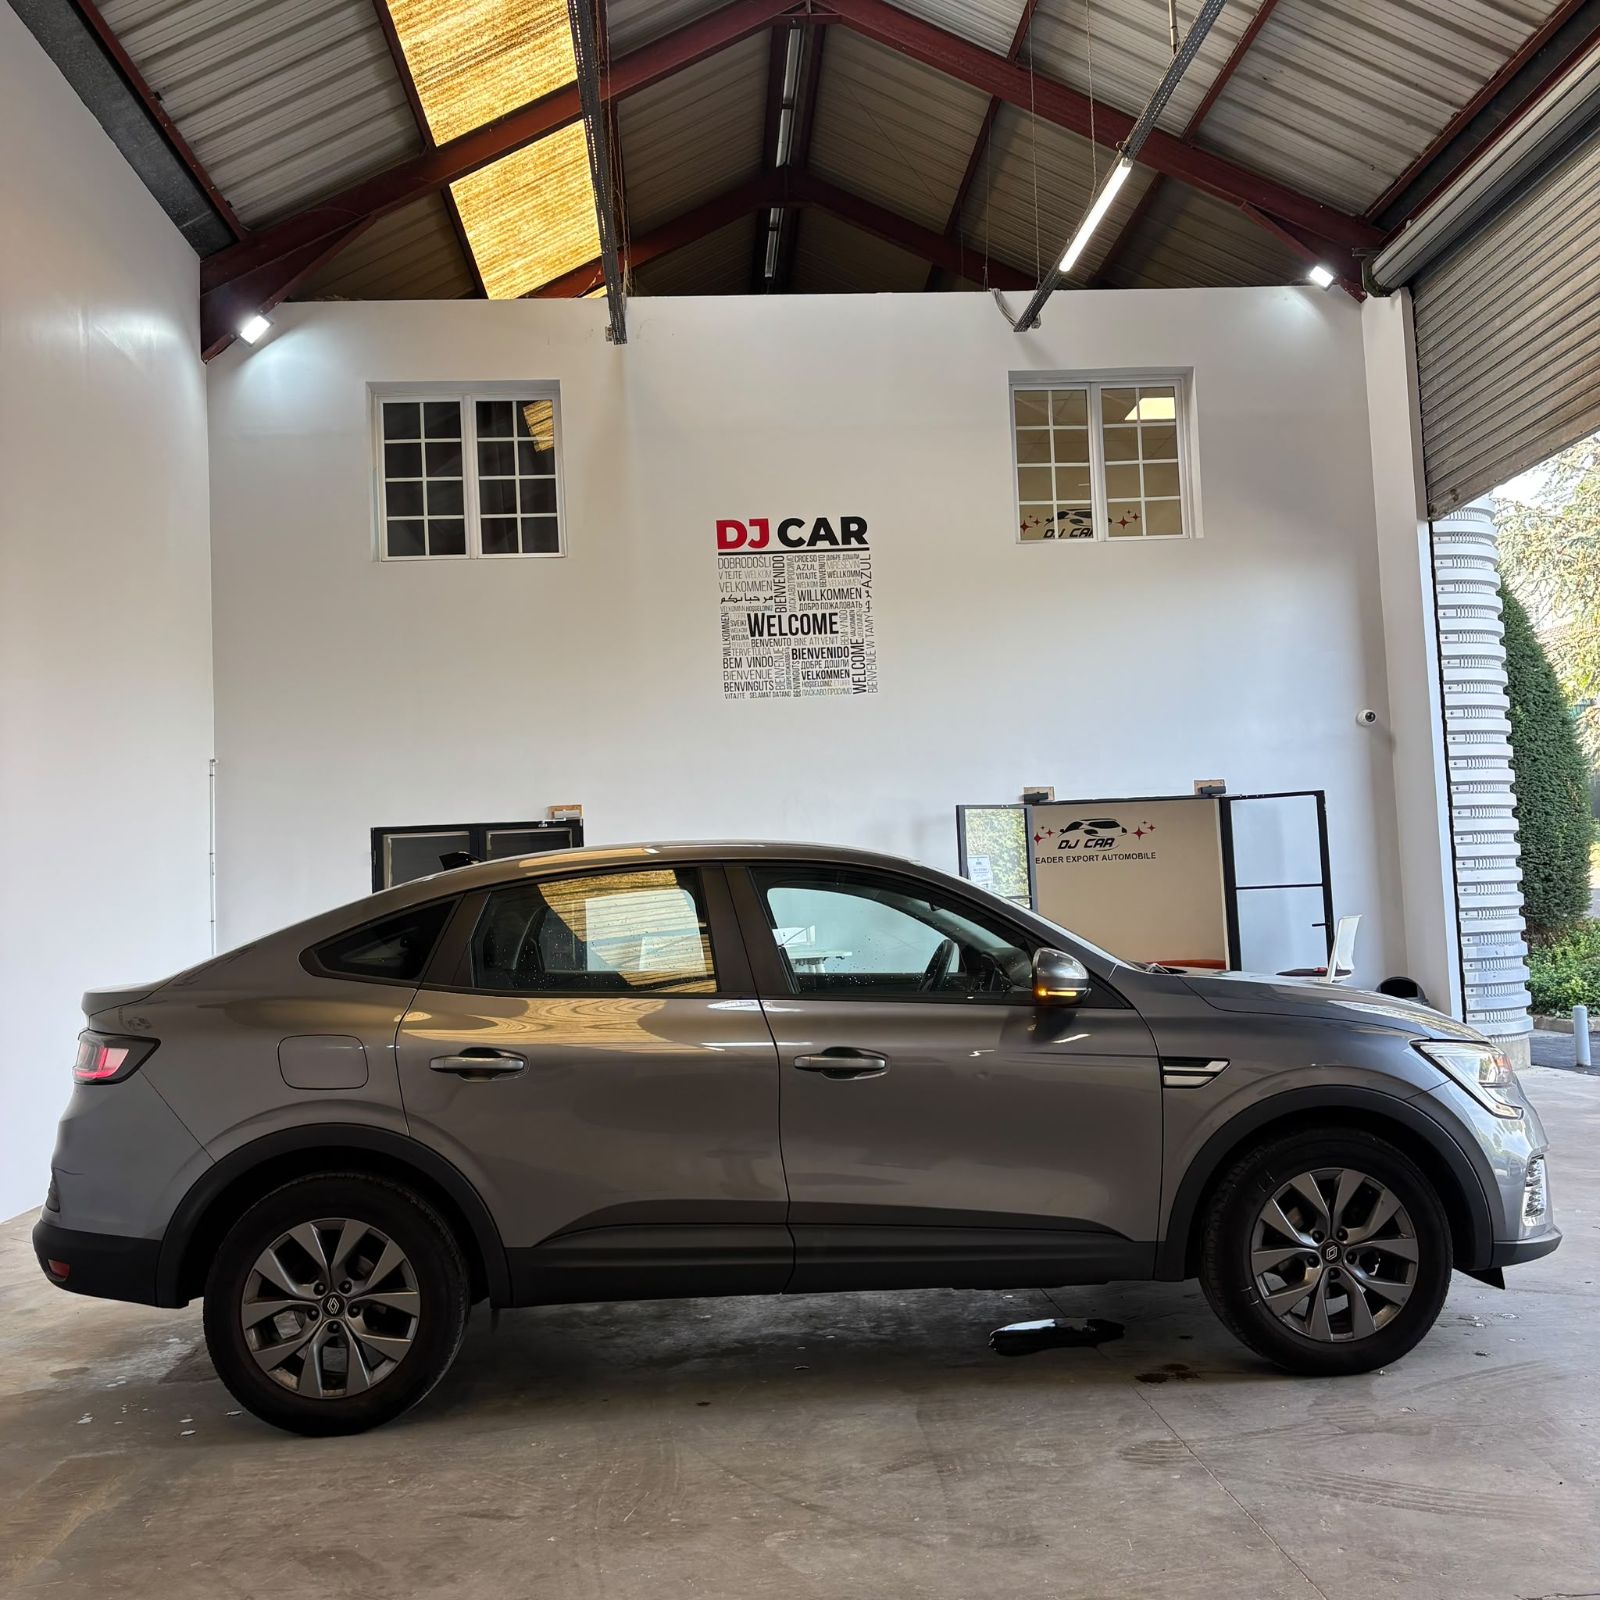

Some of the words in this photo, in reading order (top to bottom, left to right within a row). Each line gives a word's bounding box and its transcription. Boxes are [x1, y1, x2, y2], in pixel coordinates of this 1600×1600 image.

[716, 518, 770, 550] DJ
[777, 516, 869, 548] CAR
[860, 554, 872, 589] AZUL
[719, 580, 773, 592] VELKOMMEN
[772, 555, 787, 613] BIENVENIDO
[797, 587, 862, 601] WILLKOMMEN
[747, 612, 839, 637] WELCOME
[751, 637, 791, 648] BENVENUTO
[792, 646, 850, 660] BIENVENIDO
[723, 657, 742, 669] BEM
[746, 656, 774, 668] VINDO
[801, 660, 822, 670] ДОБРЕ
[850, 638, 867, 695] WELCOME
[723, 669, 773, 681] BIENVENUE
[801, 669, 850, 680] VELKOMMEN
[724, 680, 774, 692] BENVINGUTS
[1057, 839, 1080, 849] DJ
[1083, 837, 1115, 848] CAR
[1035, 856, 1064, 864] EADER
[1066, 854, 1099, 863] EXPORT
[1101, 852, 1156, 861] AUTOMOBILE
